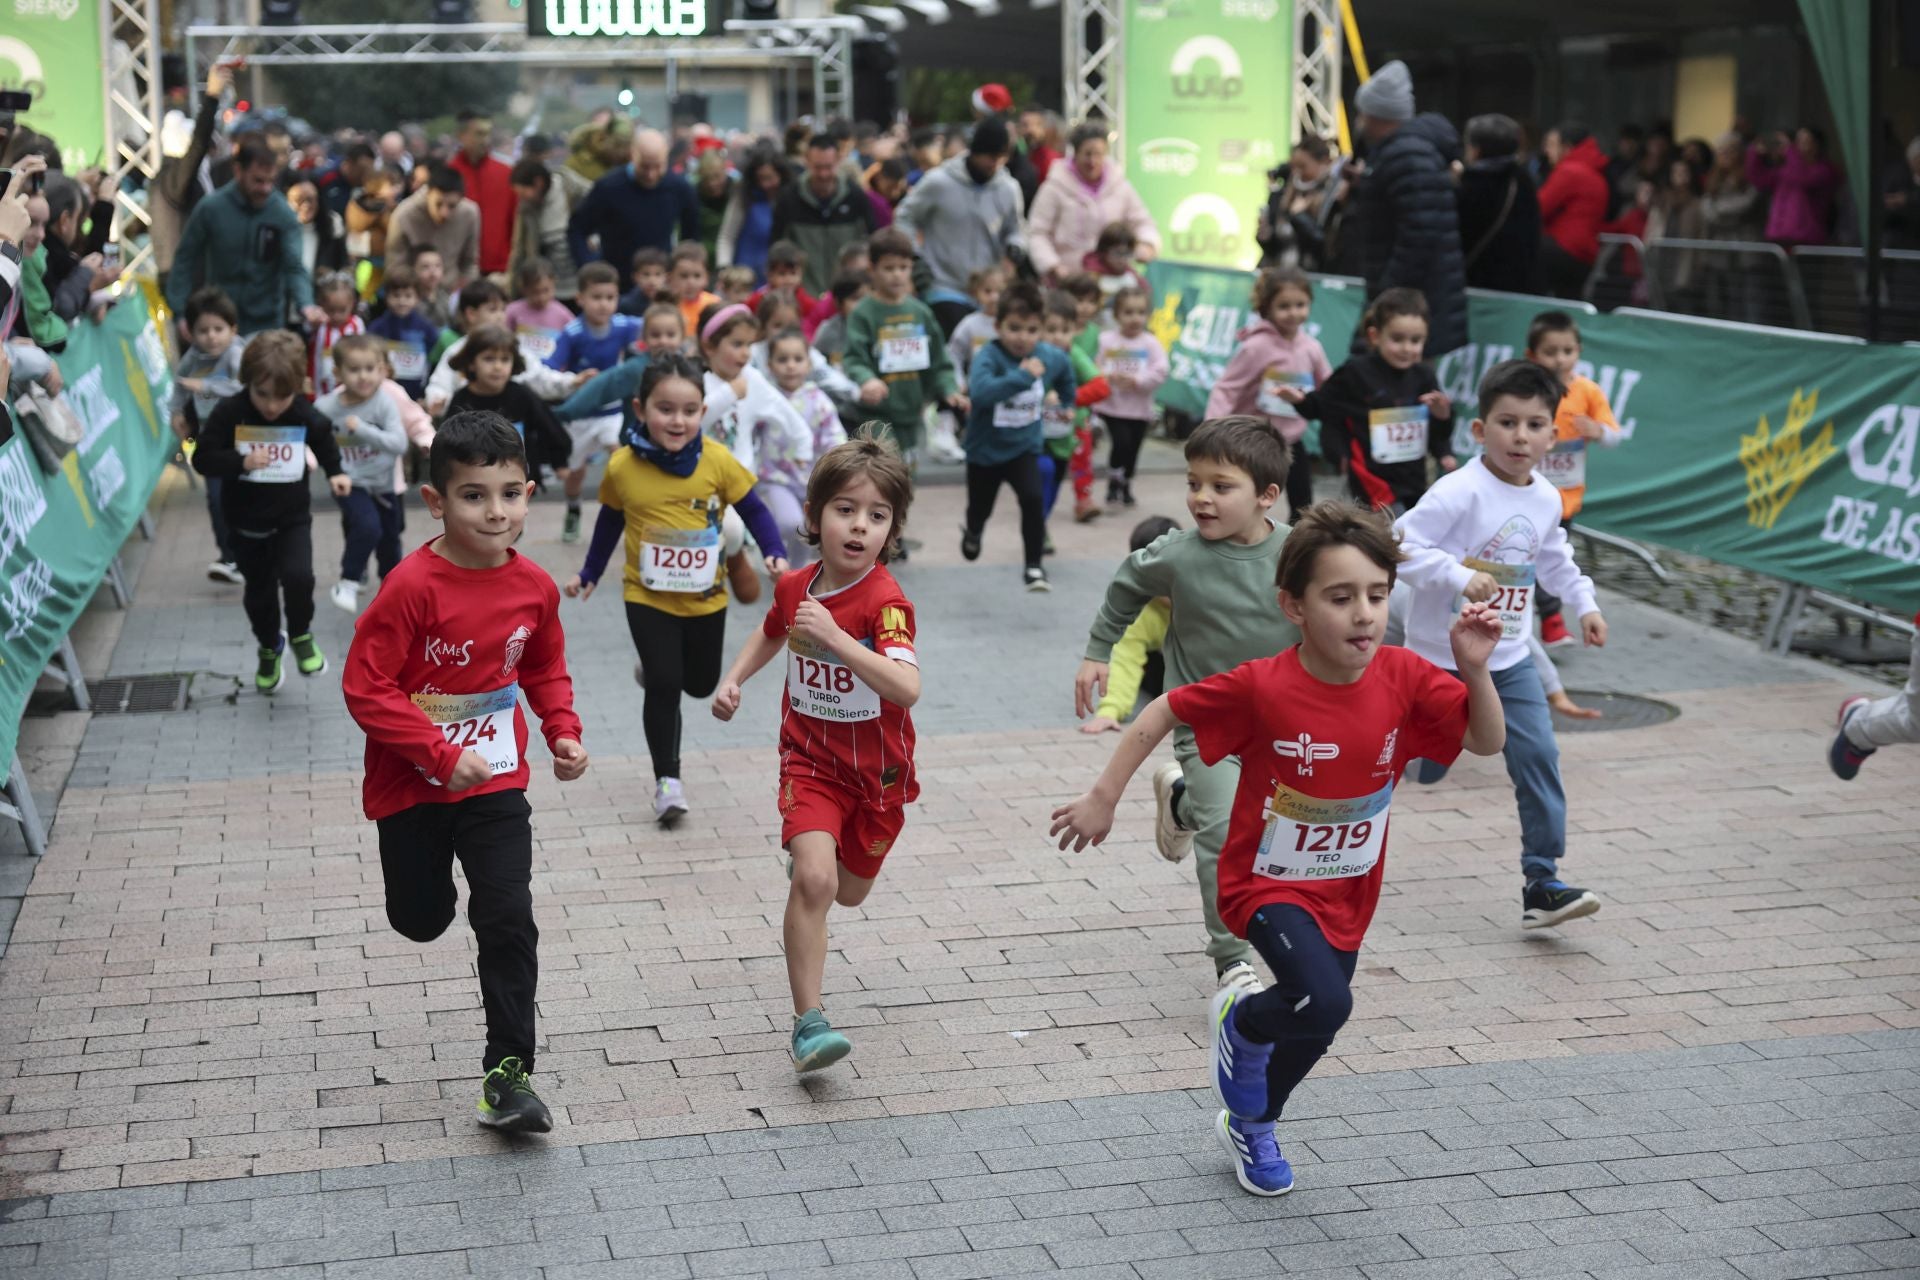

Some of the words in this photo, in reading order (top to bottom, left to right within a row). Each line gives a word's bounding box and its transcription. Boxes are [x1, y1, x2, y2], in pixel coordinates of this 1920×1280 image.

[1847, 403, 1920, 498] CA
[1820, 494, 1878, 550] DE
[1867, 507, 1920, 565] AS
[653, 547, 708, 569] 1209
[1488, 587, 1528, 612] 213
[796, 656, 855, 694] 1218
[808, 689, 841, 704] TURBO
[811, 703, 870, 719] PDMSiero
[1278, 790, 1329, 815] Carrera
[1295, 820, 1372, 852] 1219
[1315, 853, 1341, 863] TEO
